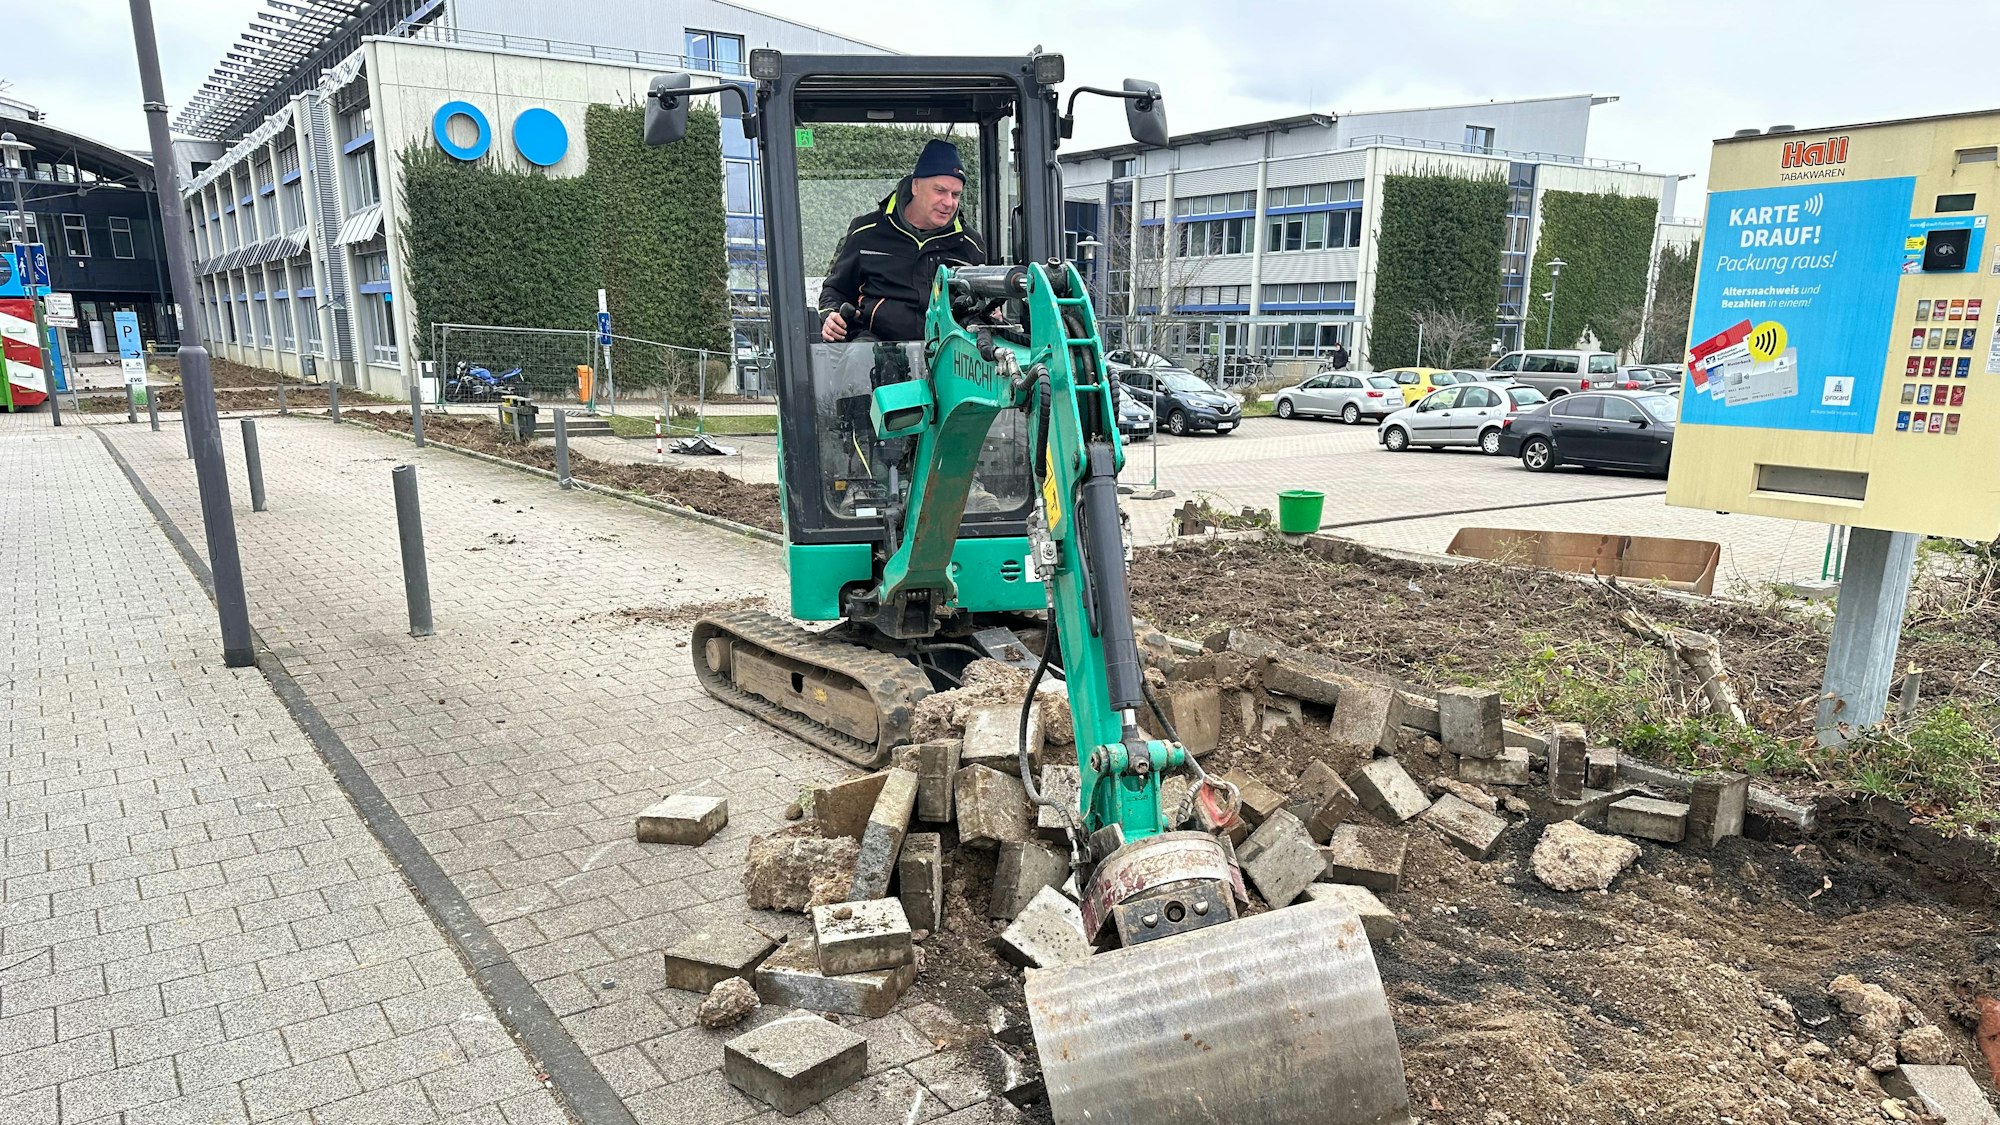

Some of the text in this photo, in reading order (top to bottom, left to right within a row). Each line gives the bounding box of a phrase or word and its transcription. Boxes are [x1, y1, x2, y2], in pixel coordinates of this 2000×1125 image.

[1781, 136, 1849, 168] Hall
[1780, 168, 1845, 181] TABAKWAREN
[1729, 204, 1800, 226] KARTE
[1740, 226, 1821, 248] DRAUF!
[1716, 250, 1838, 275] Packung raus!
[1722, 284, 1821, 296] Altersnachweis und
[1721, 298, 1812, 308] Bezahlen in einem!
[123, 325, 132, 338] P
[953, 349, 992, 392] HITACHI
